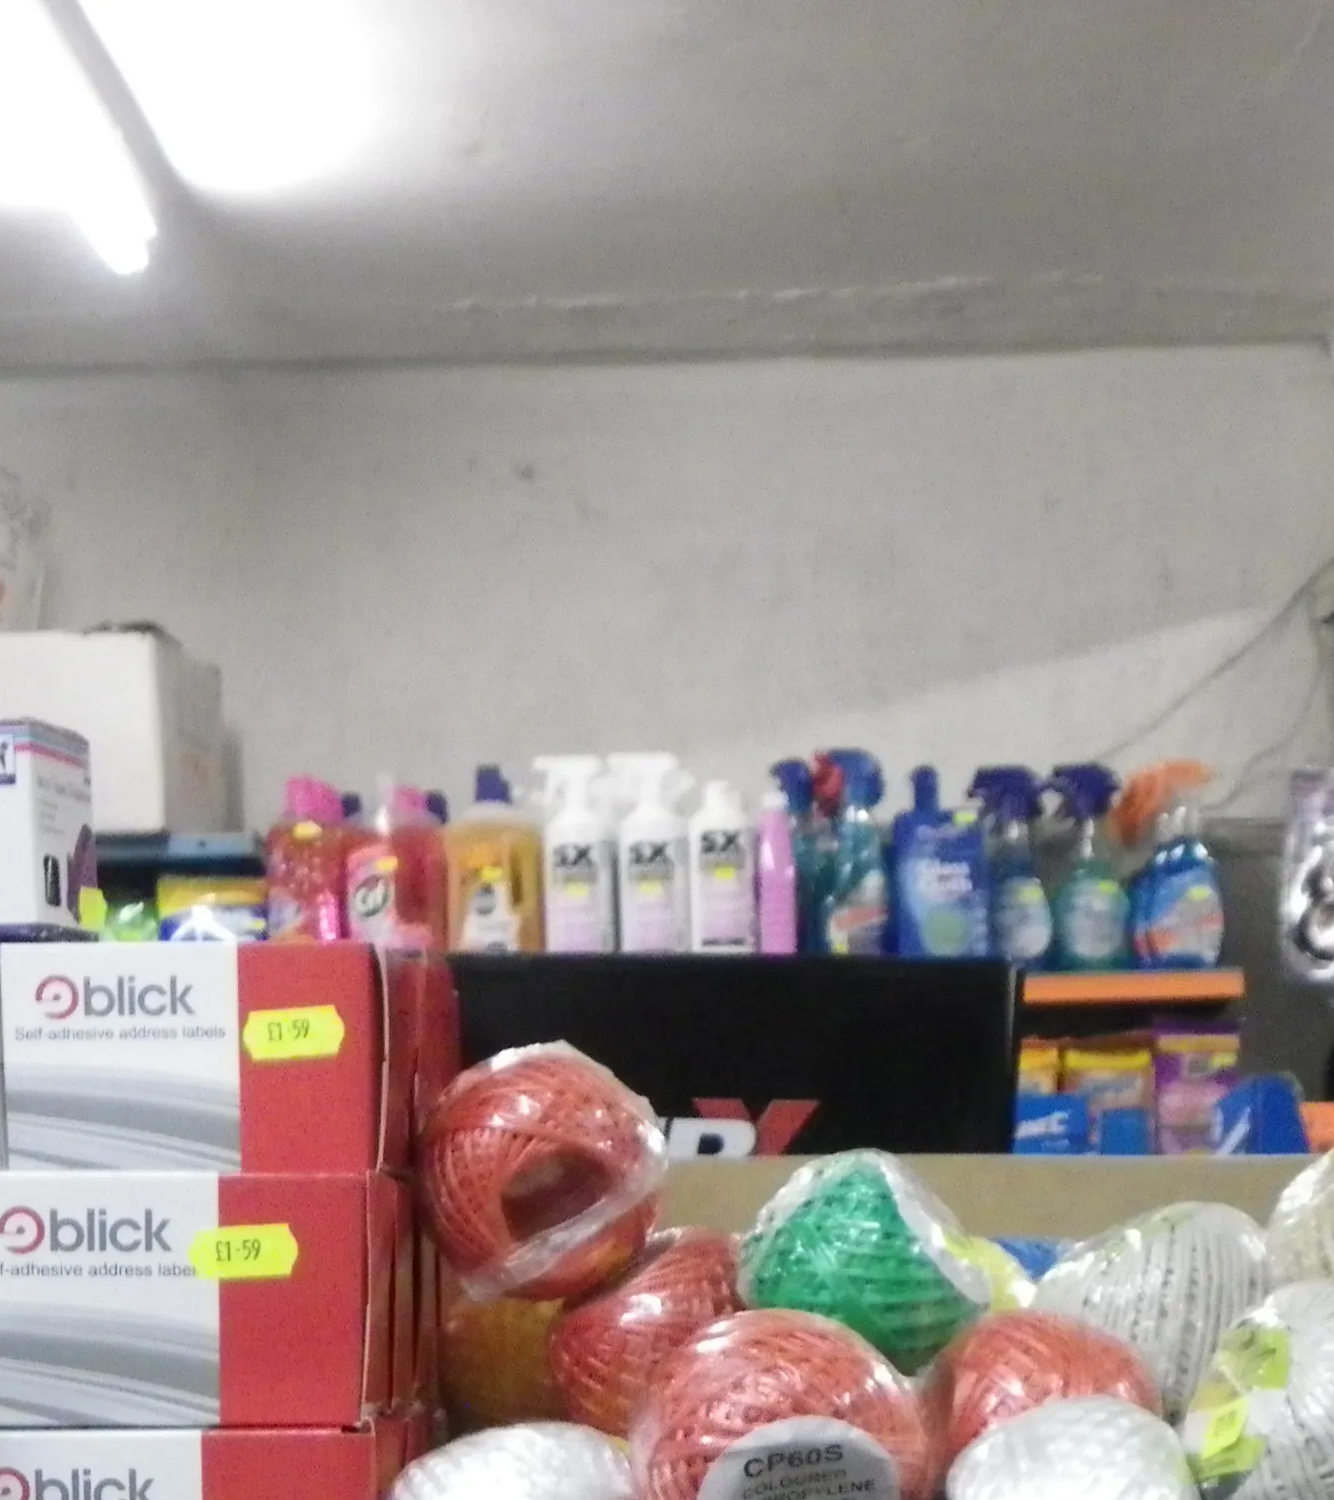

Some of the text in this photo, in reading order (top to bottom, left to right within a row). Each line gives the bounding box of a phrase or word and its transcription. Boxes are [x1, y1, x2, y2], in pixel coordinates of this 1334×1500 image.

[84, 975, 195, 1016] blick
[15, 1025, 226, 1042] Self-adhesive address labels
[50, 1208, 173, 1253] blick
[88, 1261, 154, 1278] address
[743, 1443, 845, 1480] CP60S
